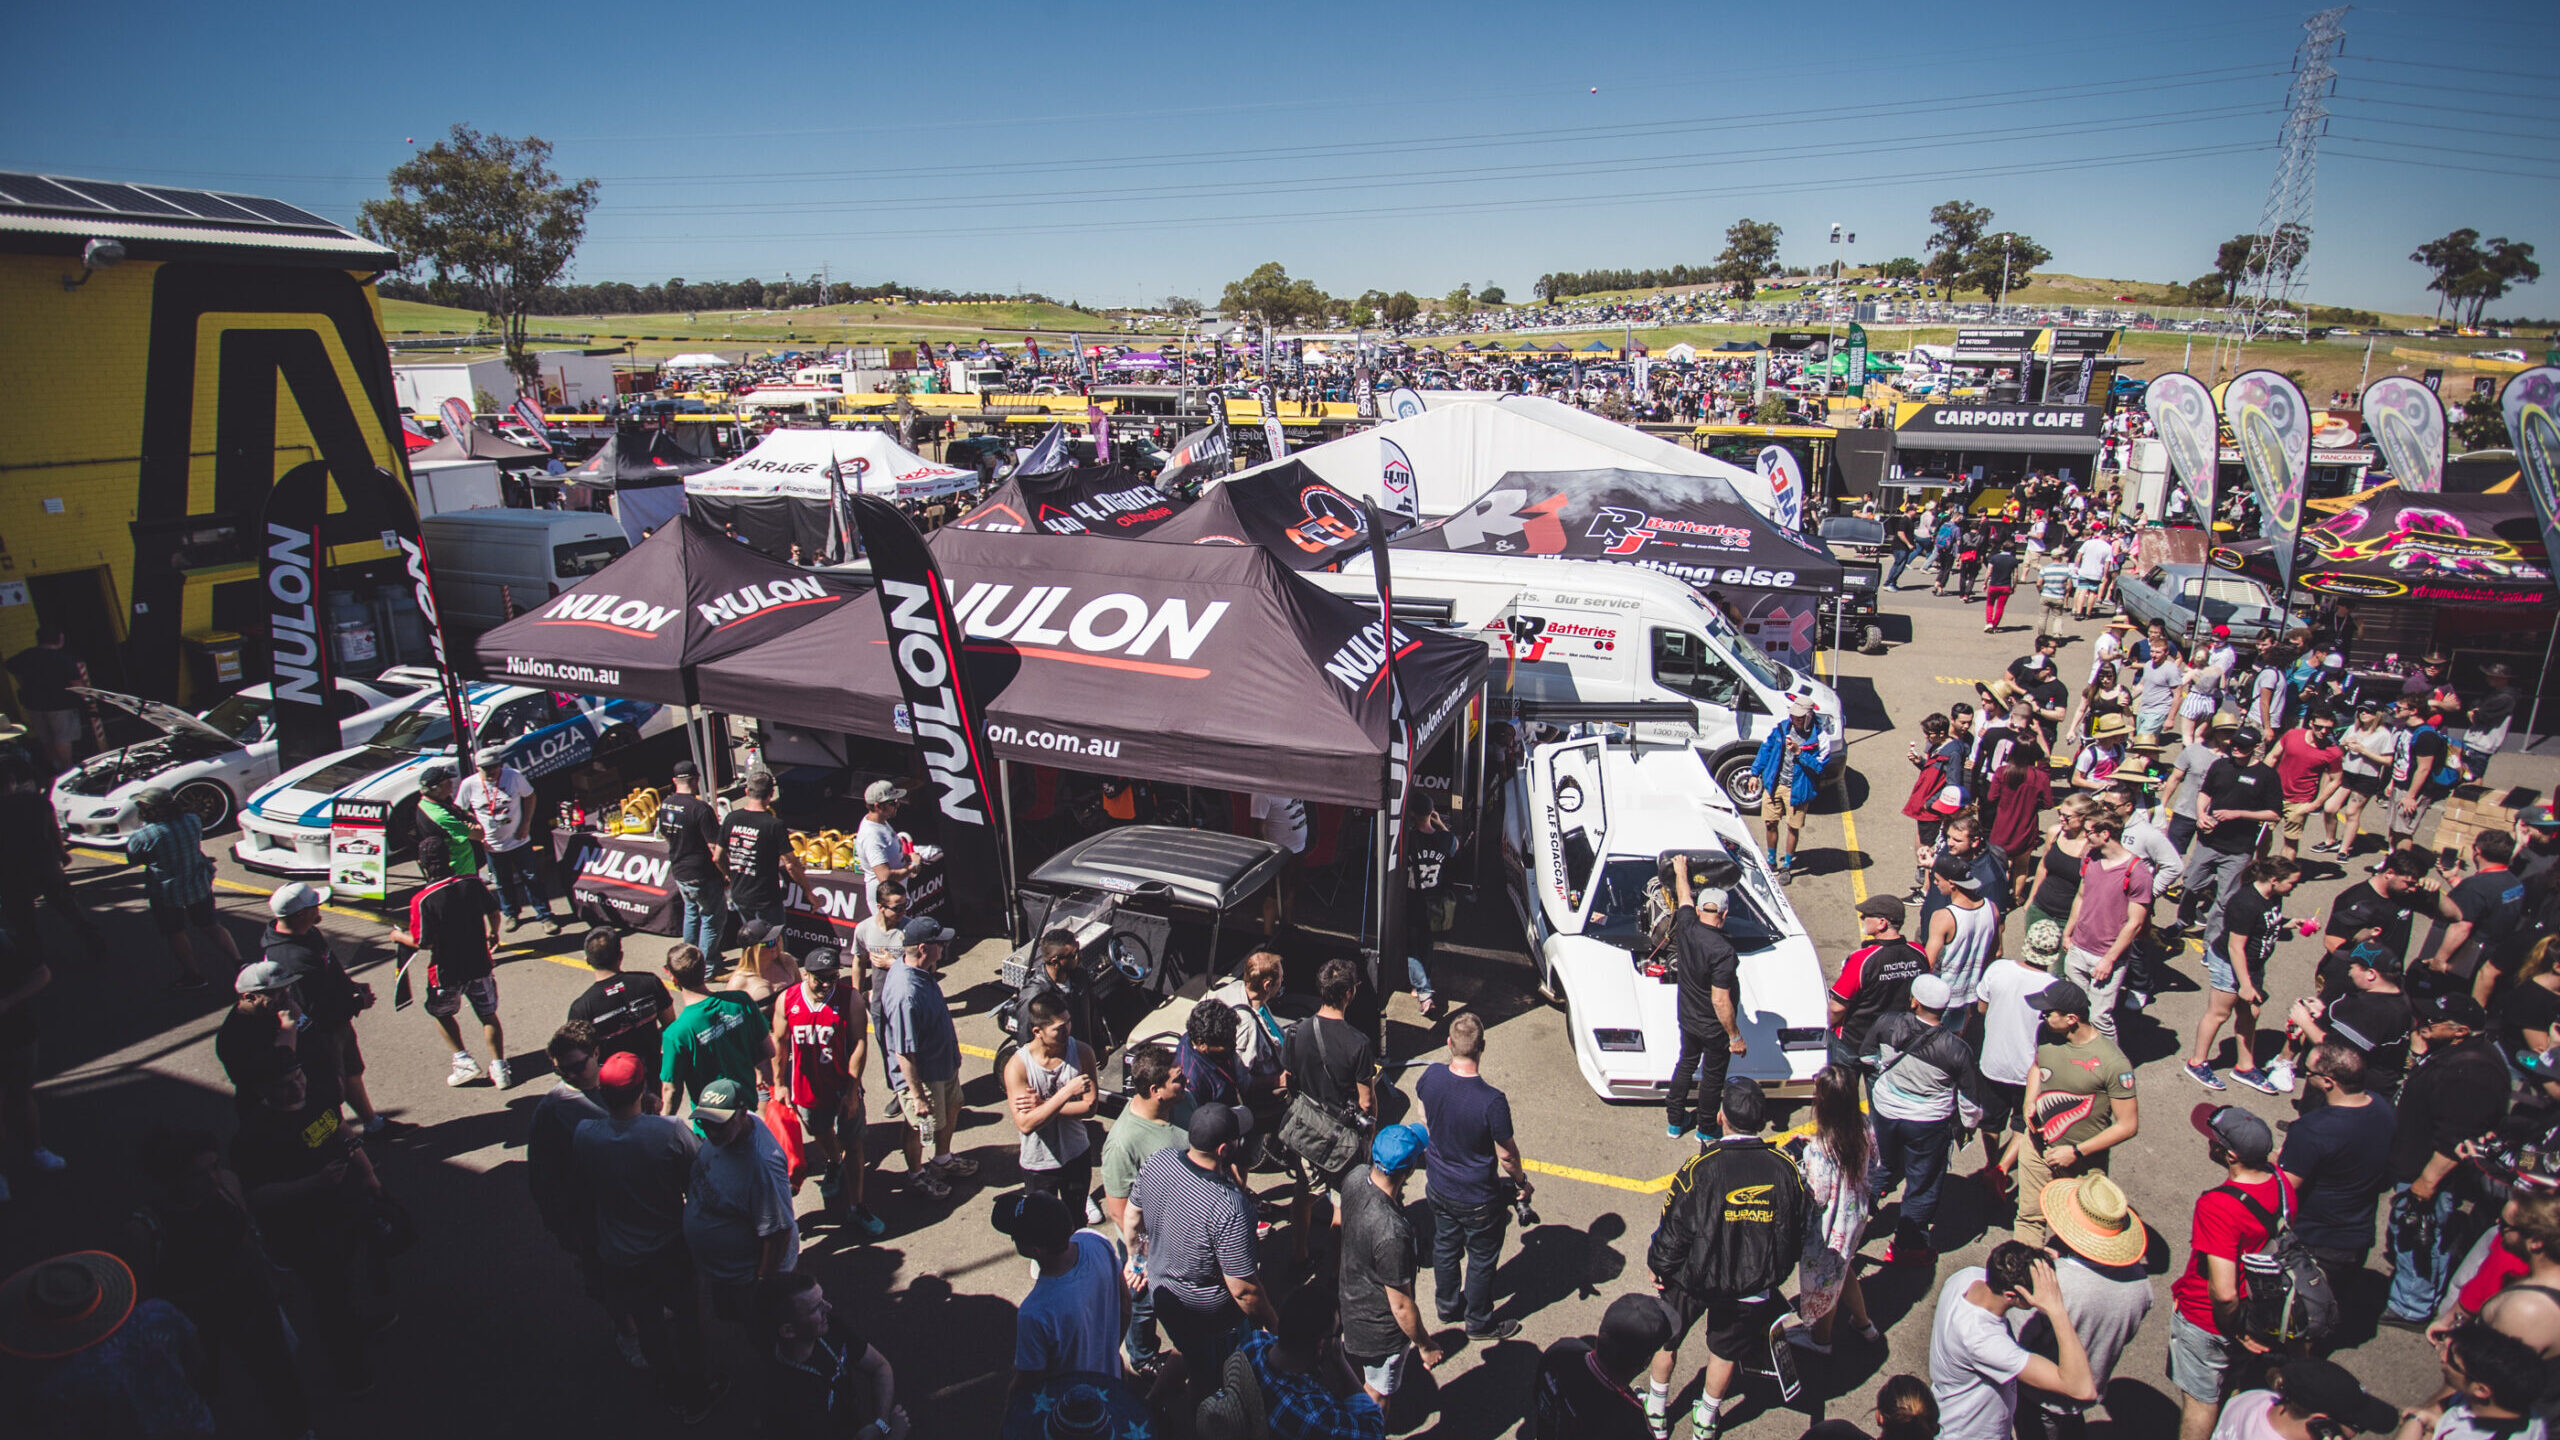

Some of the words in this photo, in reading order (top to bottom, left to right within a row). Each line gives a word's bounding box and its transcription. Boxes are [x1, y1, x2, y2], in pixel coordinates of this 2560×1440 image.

[1934, 410, 2029, 428] CARPORT
[2033, 412, 2084, 428] CAFE
[1645, 516, 1752, 538] Batteries
[2392, 542, 2456, 554] PERFORMANCE
[2457, 547, 2495, 556] CLUTCH
[1720, 566, 1796, 588] else
[2321, 584, 2362, 594] PERFORMANCE
[2363, 588, 2388, 596] CLUTCH
[2411, 585, 2543, 603] xtremeclutch.com.au
[698, 576, 829, 627] NULON
[1554, 594, 1579, 606] Our
[1583, 598, 1641, 610] service
[268, 522, 322, 706] NULON
[543, 594, 681, 633] NULON
[1547, 621, 1617, 639] Batteries
[506, 656, 620, 686] Nulon.com.au
[880, 578, 986, 827] NULON
[1416, 676, 1470, 750] Nulon.com.au
[335, 804, 383, 819] NULON
[1546, 804, 1557, 828] ALF
[731, 825, 760, 836] NULON
[574, 846, 672, 888] NULON
[1549, 831, 1563, 886] SCIACCA
[782, 882, 858, 920] ULON
[1879, 968, 1923, 982] motorsport
[1883, 960, 1918, 971] mcintyre
[793, 1024, 835, 1045] EVO
[1724, 1209, 1774, 1218] SUBARU
